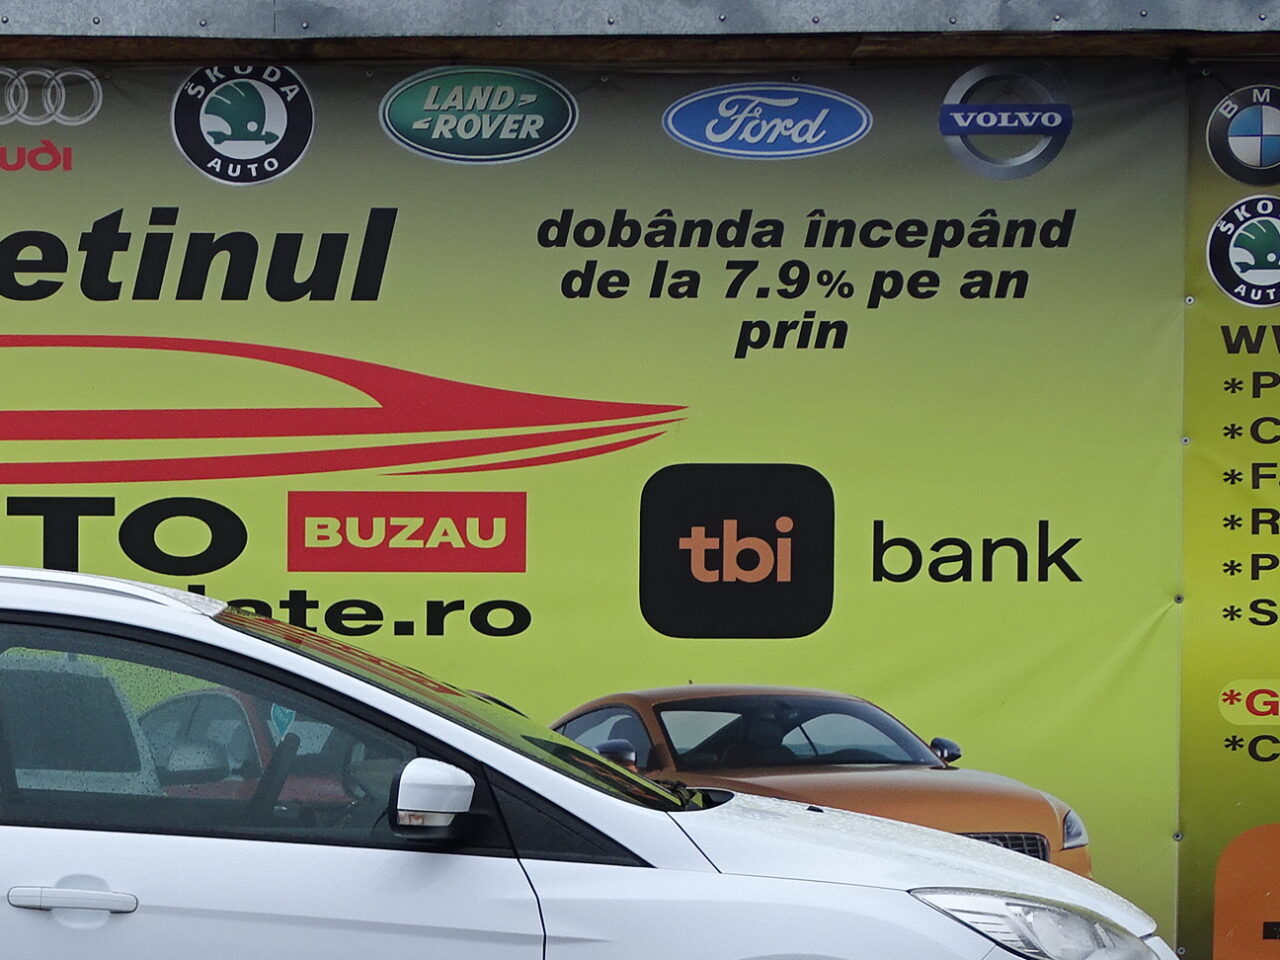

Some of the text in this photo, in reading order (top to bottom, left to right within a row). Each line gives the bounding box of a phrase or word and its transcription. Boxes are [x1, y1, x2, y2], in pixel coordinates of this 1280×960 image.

[431, 113, 545, 140] ROVER
[705, 95, 830, 144] Ford
[949, 111, 1063, 128] VOLVO
[207, 157, 279, 178] AUTO
[536, 208, 1077, 258] dobânda începând
[560, 259, 1029, 310] de la 7.9% pe an
[734, 310, 849, 359] prin
[304, 516, 507, 549] BUZAU
[678, 515, 1083, 583] tbi bank
